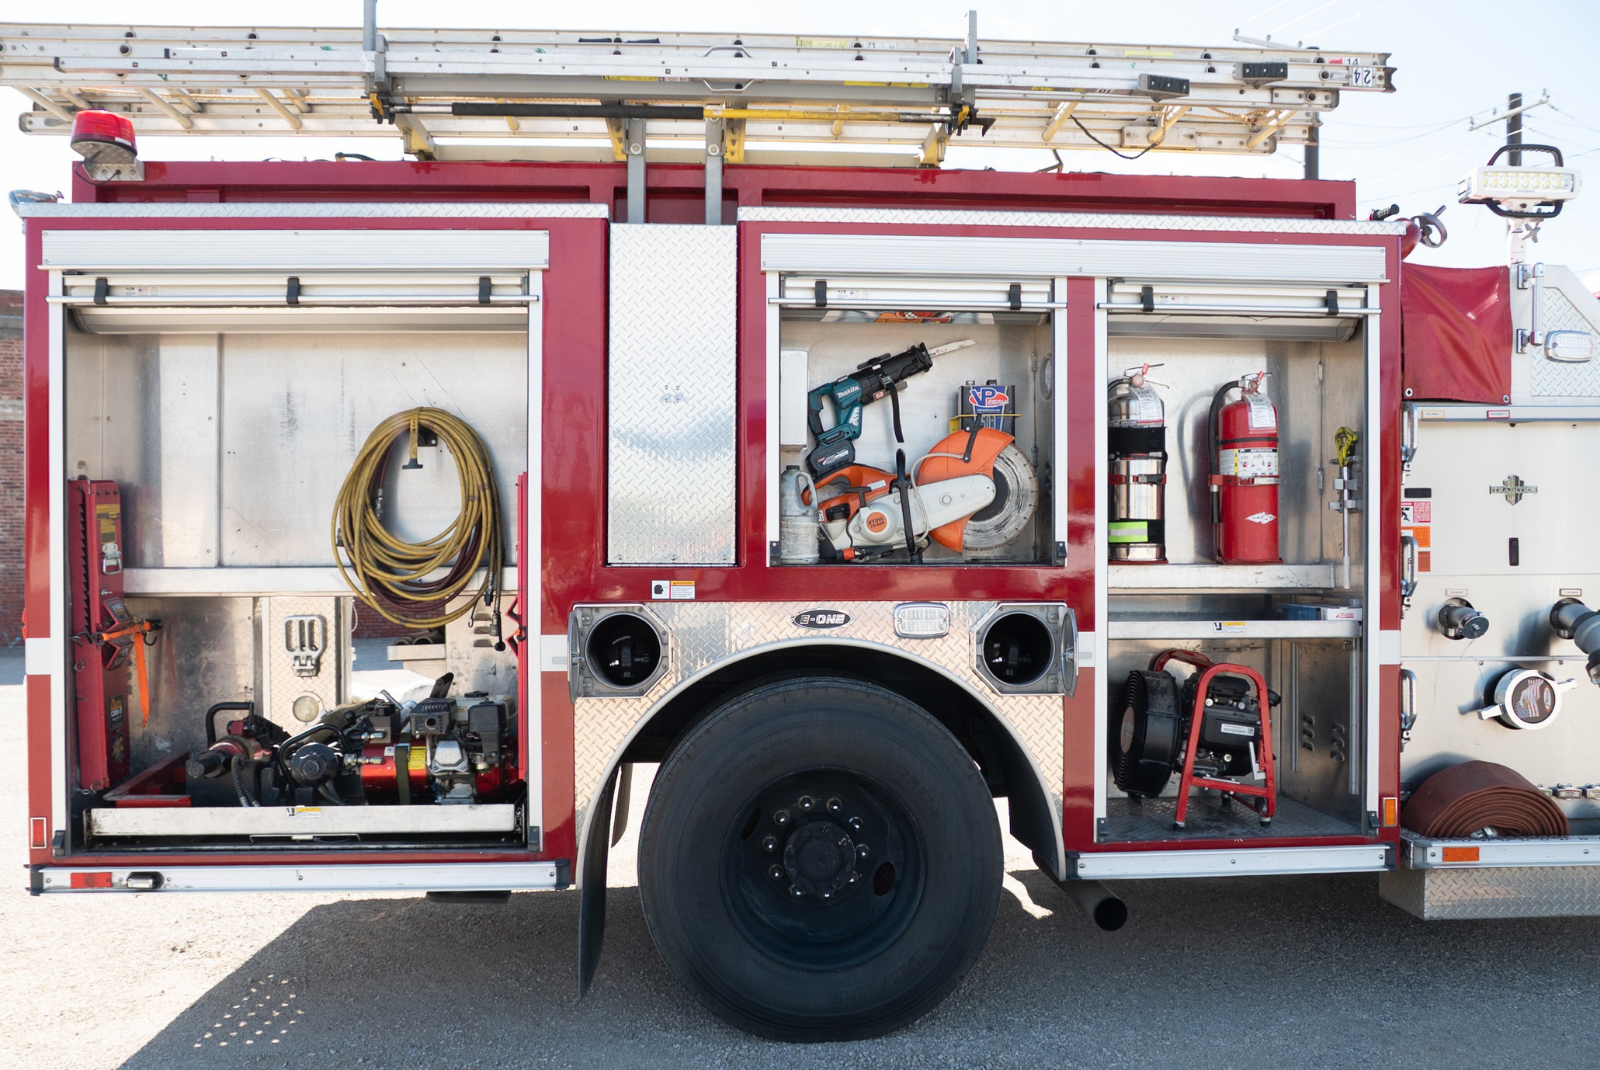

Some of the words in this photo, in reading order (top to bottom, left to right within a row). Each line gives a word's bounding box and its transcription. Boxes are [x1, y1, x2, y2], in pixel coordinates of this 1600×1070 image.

[1353, 69, 1372, 84] 24
[970, 387, 997, 407] VP
[868, 516, 884, 525] STIHL
[800, 614, 845, 624] E-ONE
